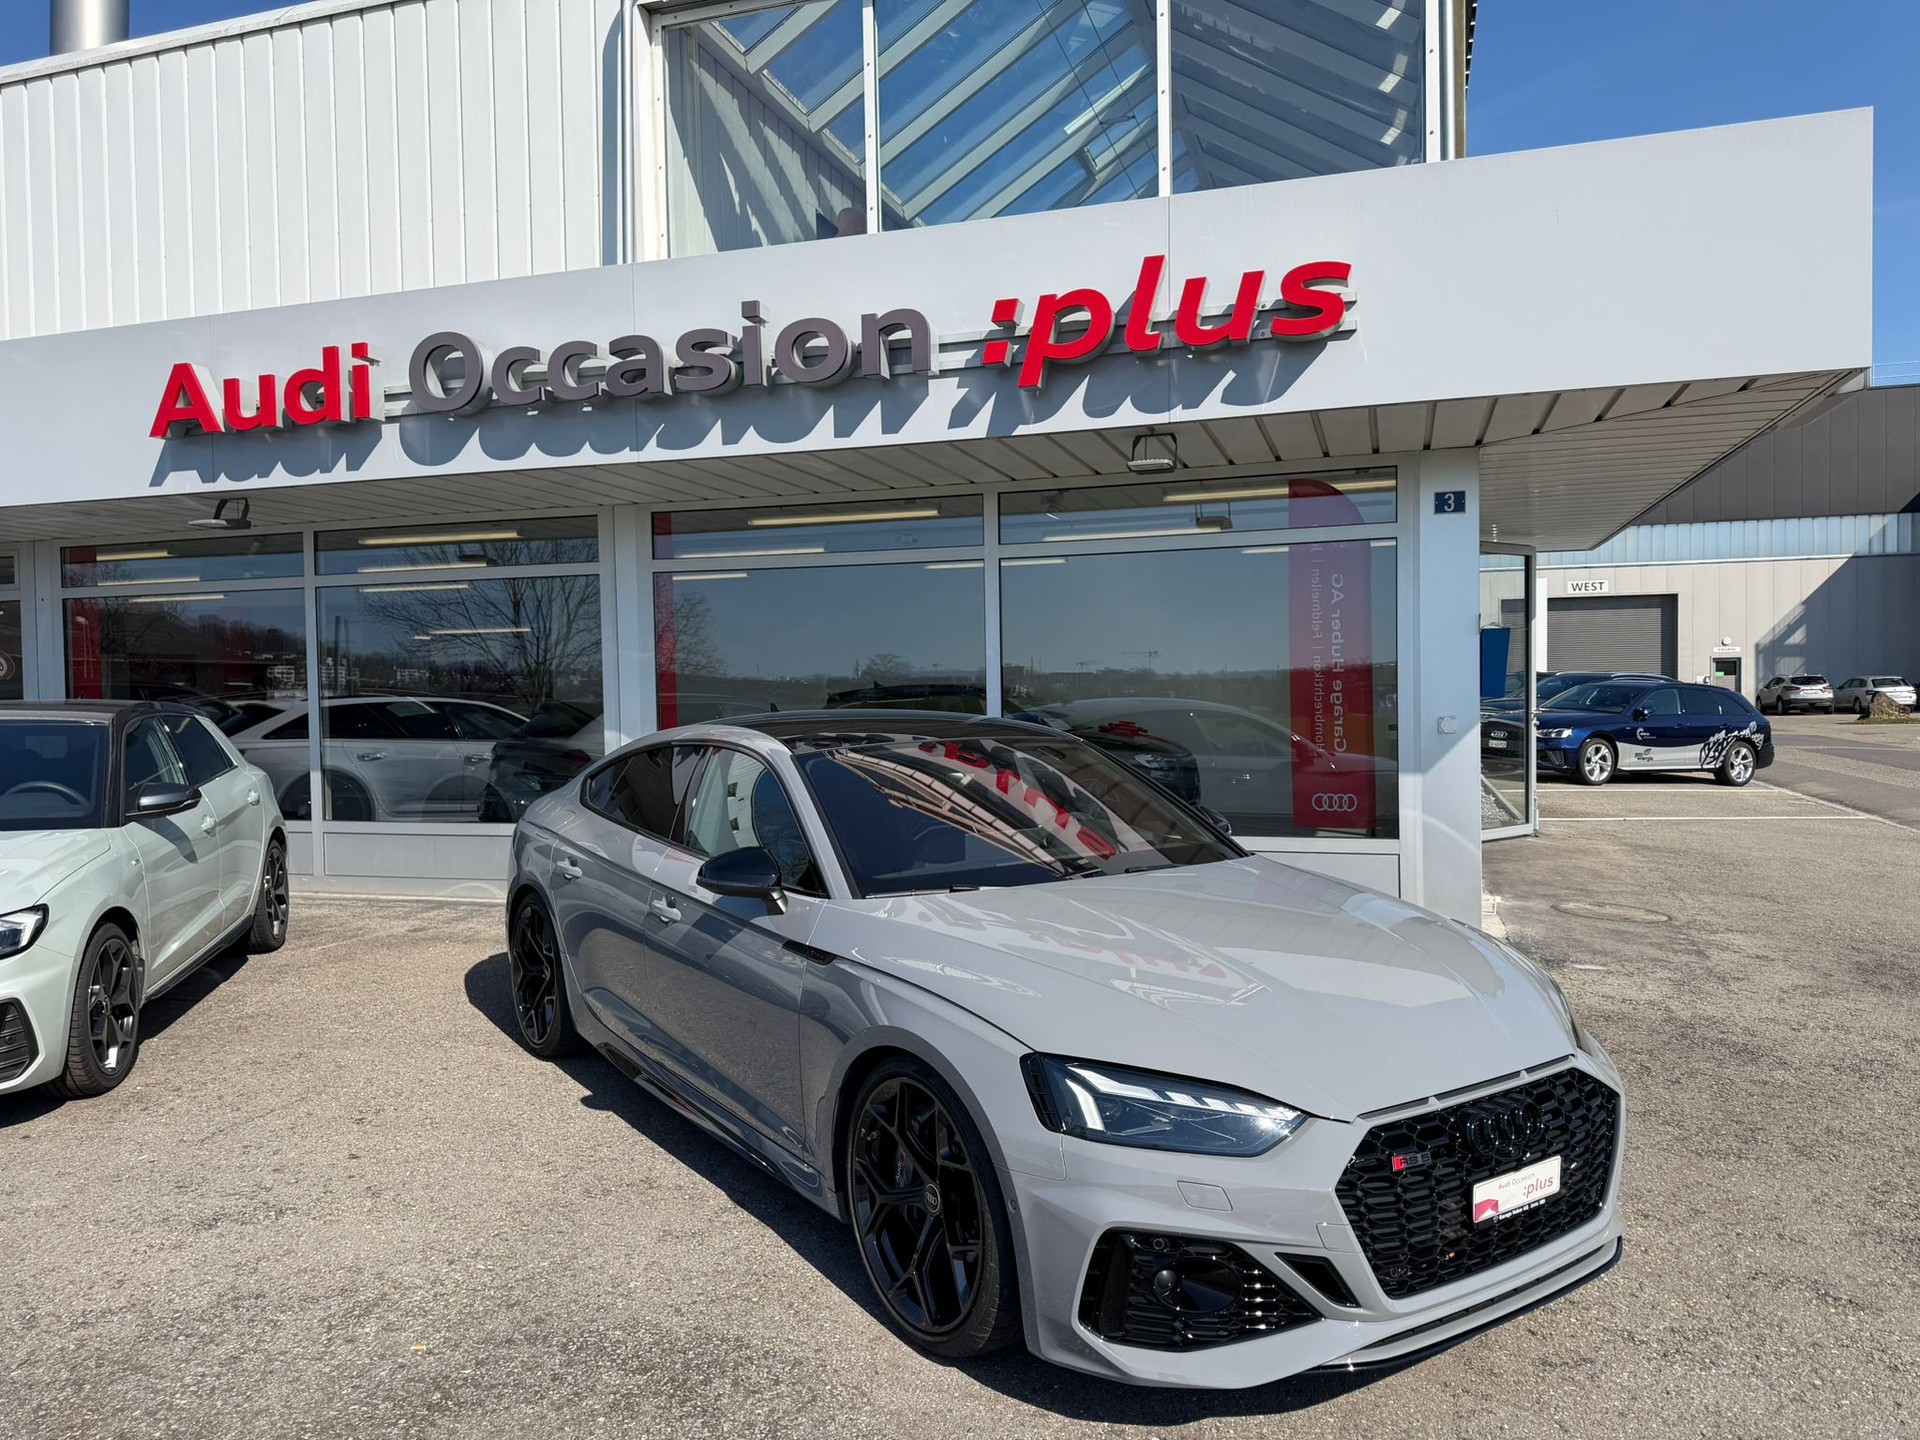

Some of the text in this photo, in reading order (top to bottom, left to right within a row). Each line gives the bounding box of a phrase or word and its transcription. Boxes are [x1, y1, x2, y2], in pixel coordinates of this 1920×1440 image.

[150, 341, 372, 439] Audi
[408, 300, 932, 411] Occasion
[1444, 493, 1455, 511] 3
[1571, 581, 1605, 592] WEST
